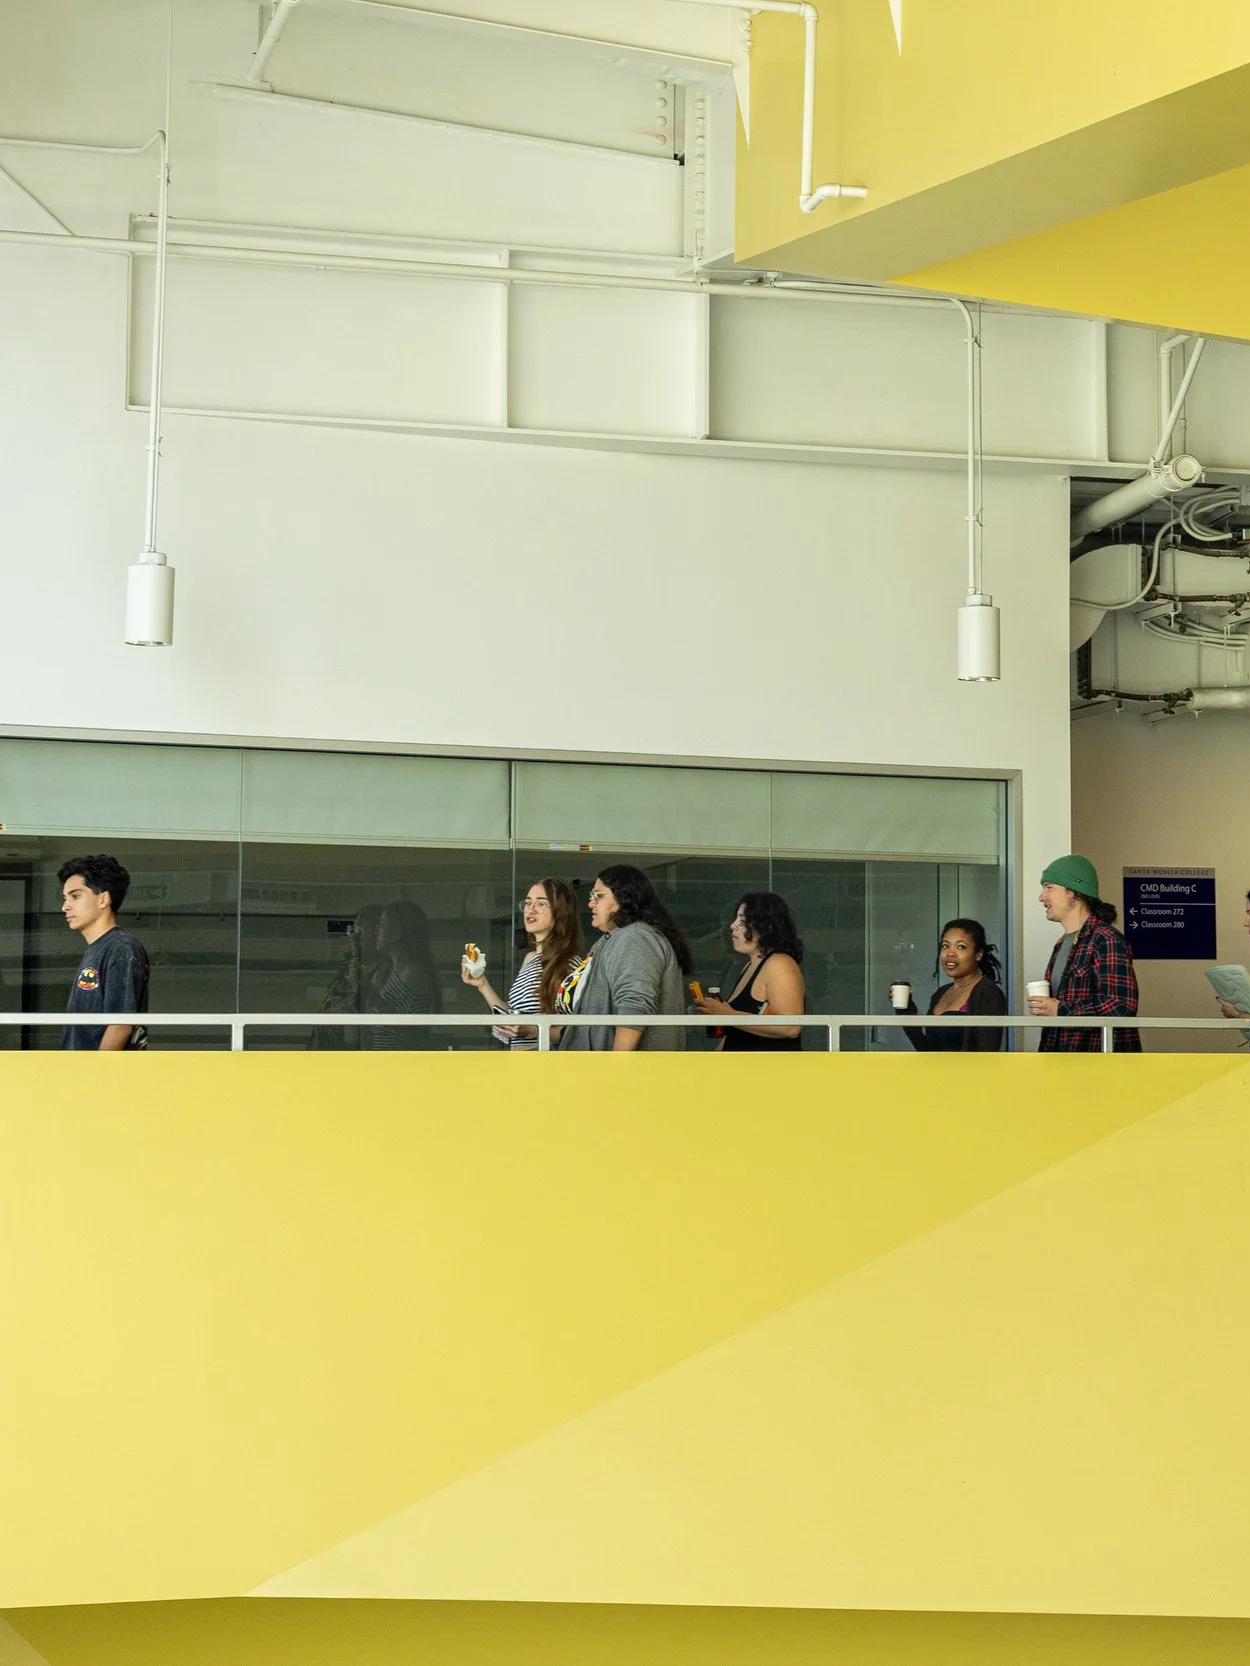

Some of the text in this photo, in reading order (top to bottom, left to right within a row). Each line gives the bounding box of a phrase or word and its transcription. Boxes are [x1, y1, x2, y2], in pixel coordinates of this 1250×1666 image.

[1140, 883, 1197, 894] CMD Building C
[1140, 907, 1172, 915] Classroom
